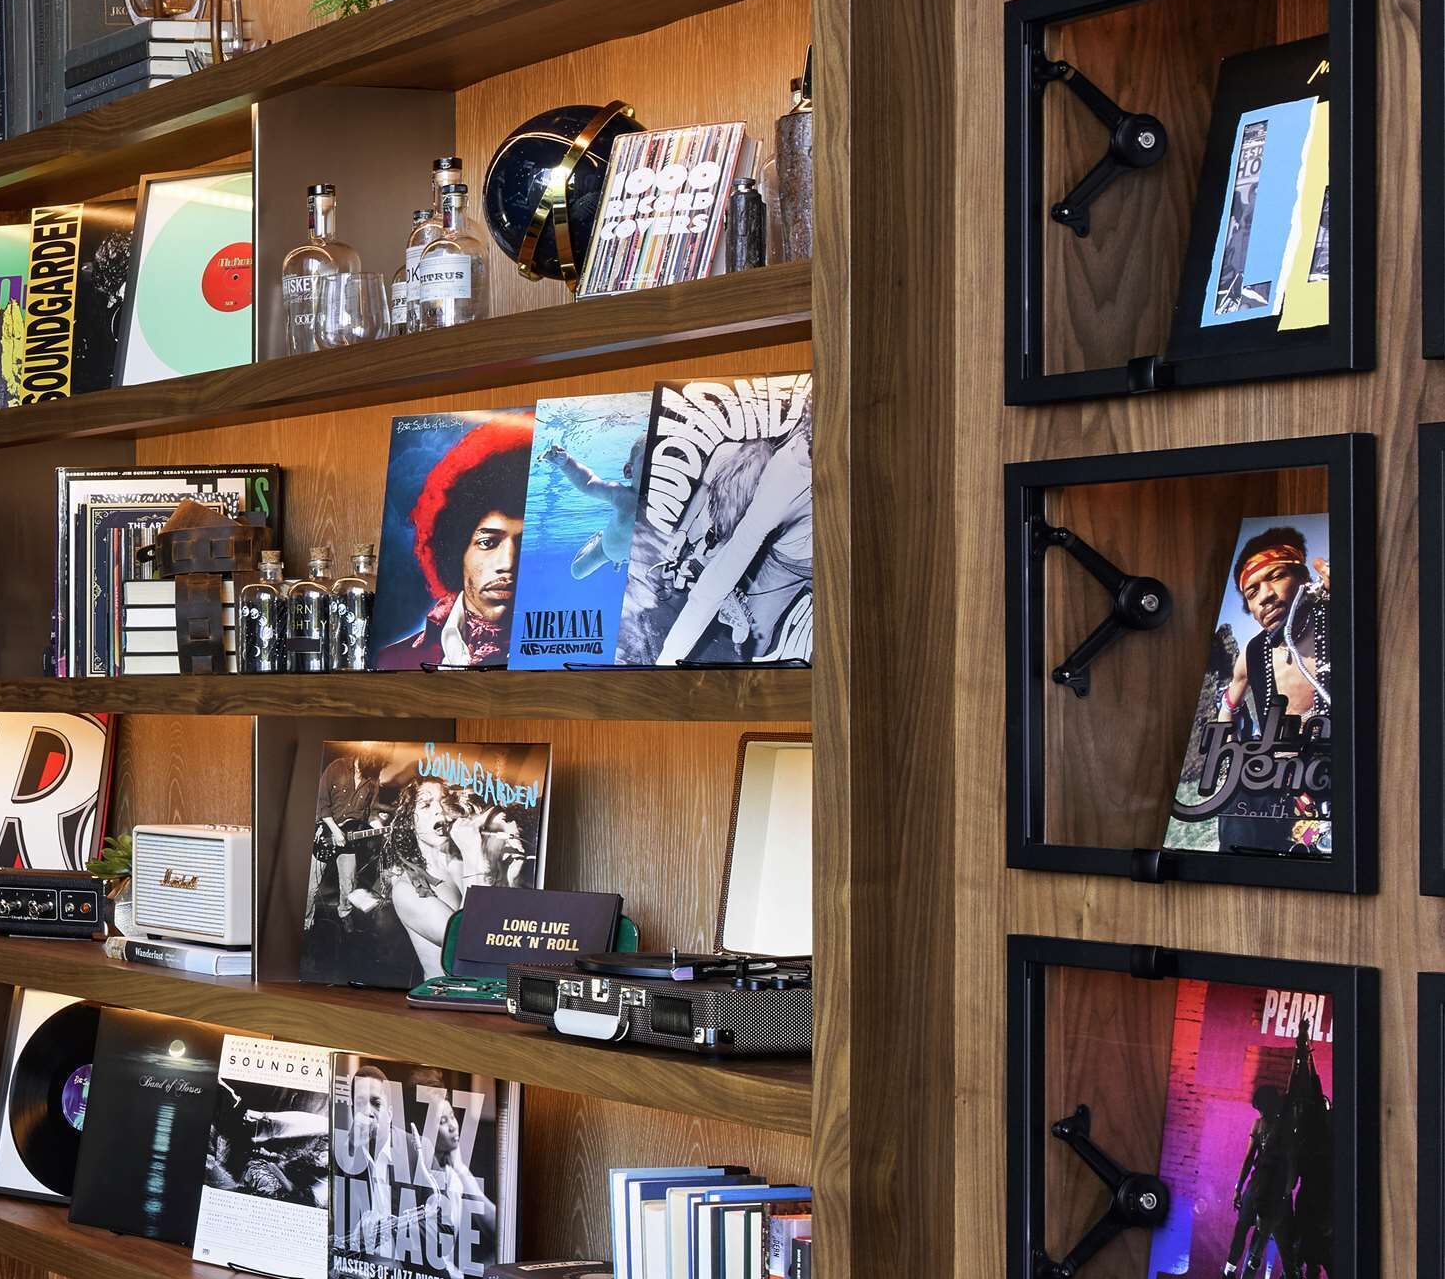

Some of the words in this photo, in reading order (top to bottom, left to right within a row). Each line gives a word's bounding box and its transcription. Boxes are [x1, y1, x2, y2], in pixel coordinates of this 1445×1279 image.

[611, 160, 722, 198] 1000
[604, 192, 715, 220] RECORD
[600, 214, 709, 241] COVERS
[522, 609, 604, 640] NIRVANA
[520, 641, 604, 657] NEVERMIND
[502, 918, 537, 934] LONG
[540, 919, 570, 936] LIVE
[135, 946, 164, 961] Wanderlust
[485, 933, 523, 948] ROCK
[547, 935, 580, 952] ROLL
[1260, 989, 1325, 1043] PEARL
[229, 1055, 324, 1078] SOUNDGA
[138, 1075, 164, 1089] Band
[164, 1079, 176, 1093] of
[174, 1078, 203, 1098] Horses
[334, 1075, 485, 1189] JAZZ
[333, 1175, 485, 1278] IMAGE
[332, 1255, 376, 1277] MASTERS
